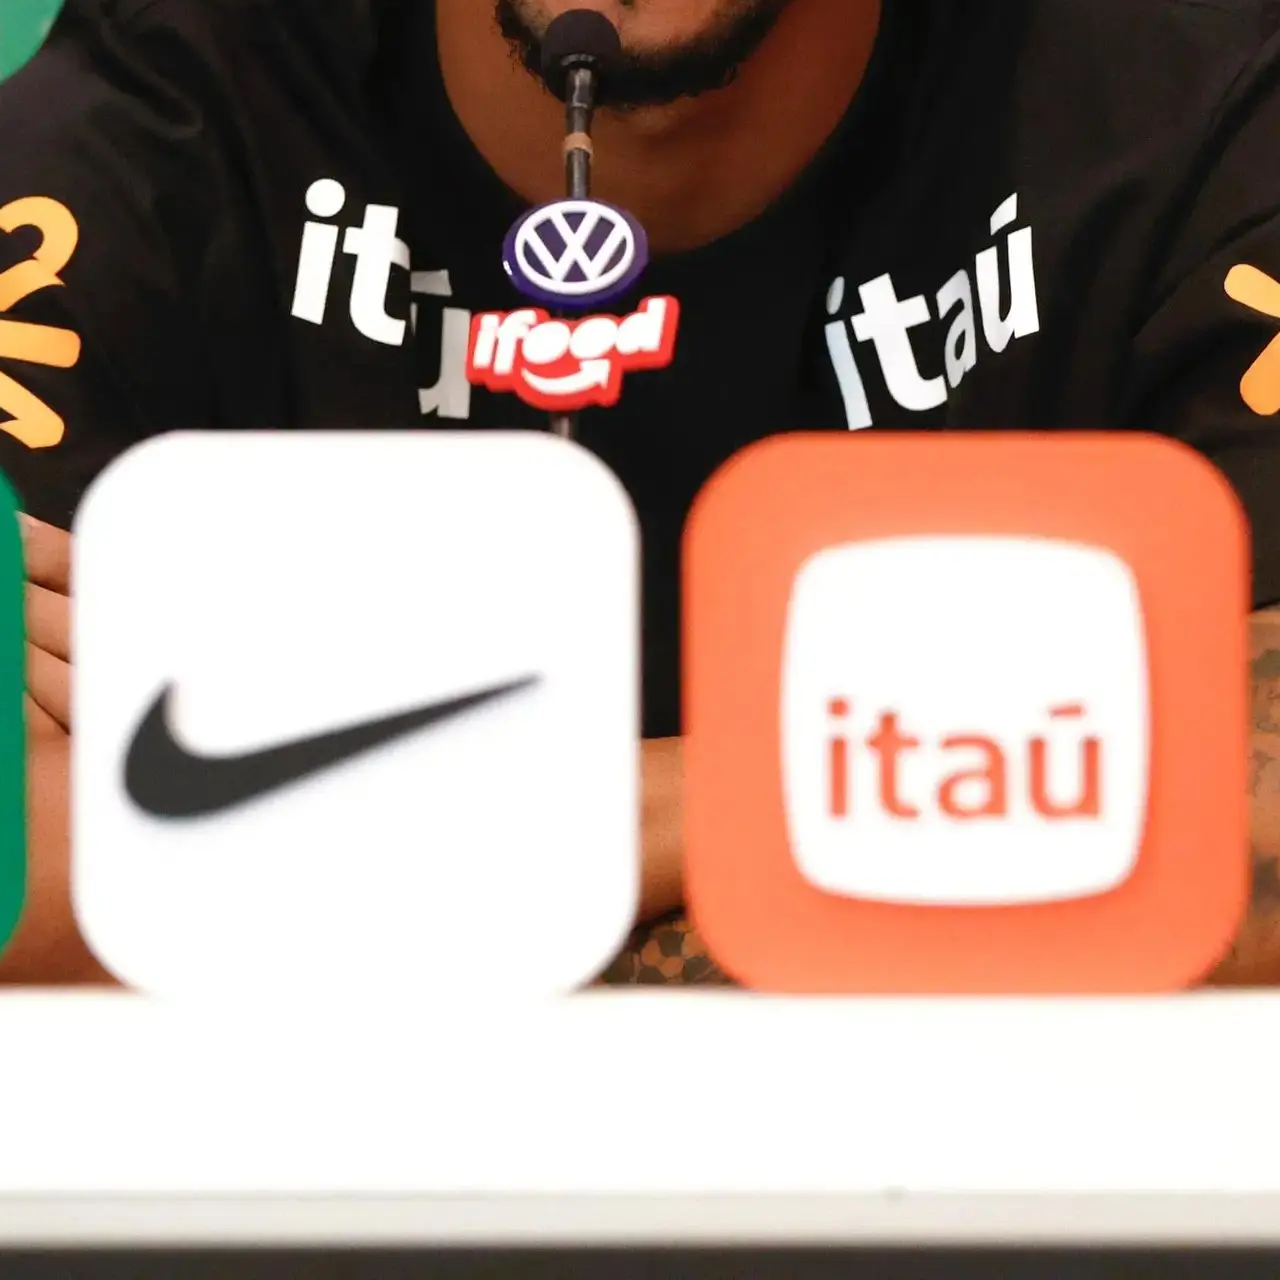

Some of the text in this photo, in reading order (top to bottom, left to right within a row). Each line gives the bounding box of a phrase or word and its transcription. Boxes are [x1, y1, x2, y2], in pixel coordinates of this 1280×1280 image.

[472, 297, 668, 376] ifood
[825, 191, 1041, 431] itaú
[827, 696, 1104, 822] itaú
